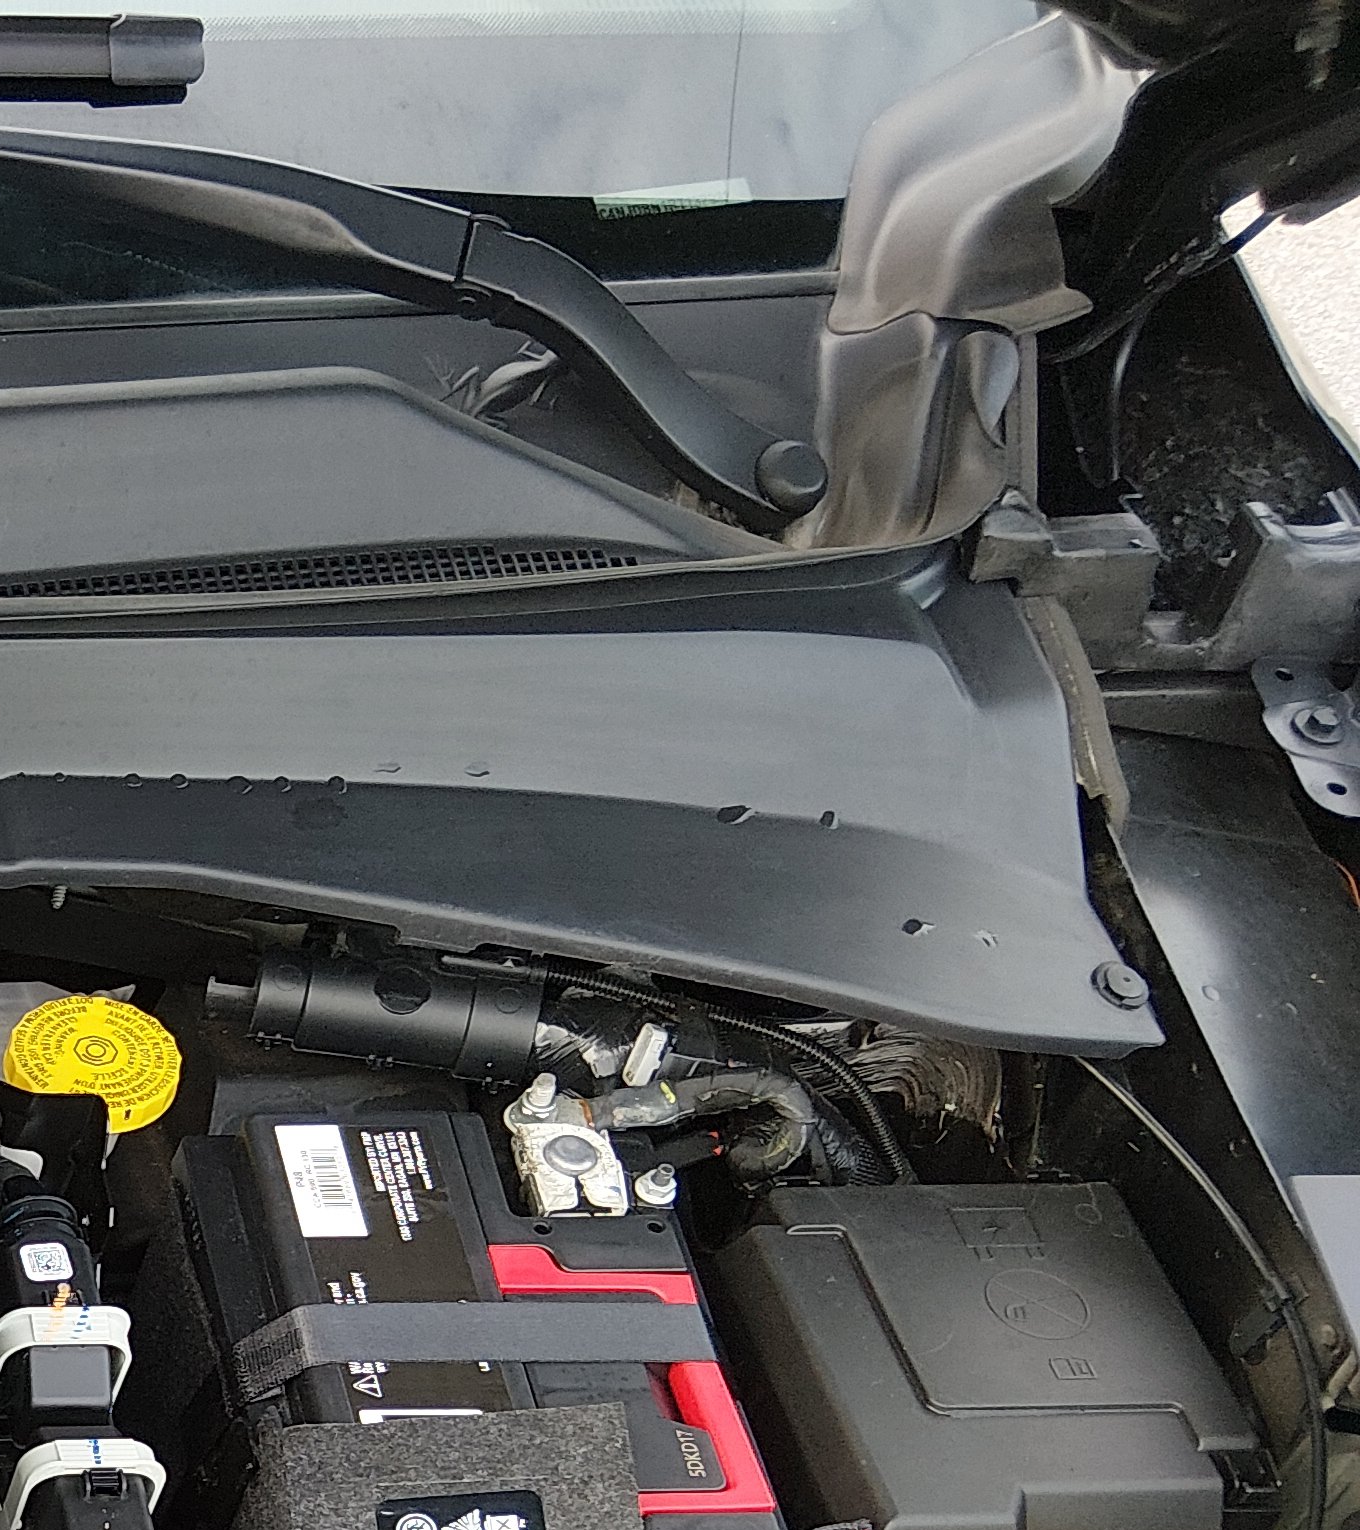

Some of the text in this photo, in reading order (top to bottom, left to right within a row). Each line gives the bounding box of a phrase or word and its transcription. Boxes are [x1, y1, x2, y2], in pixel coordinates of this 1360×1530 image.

[107, 1009, 138, 1025] AVANT
[27, 1048, 41, 1062] USE
[41, 1052, 57, 1066] CAP
[104, 1000, 127, 1010] MISE
[121, 1097, 137, 1107] DE
[14, 1053, 50, 1090] CONTAINER
[98, 1067, 148, 1091] PROVENANT
[379, 1157, 395, 1184] CENTER
[387, 1184, 406, 1225] CORPORATE
[404, 1202, 419, 1222] SUITE
[675, 1429, 707, 1478] 5DKD17
